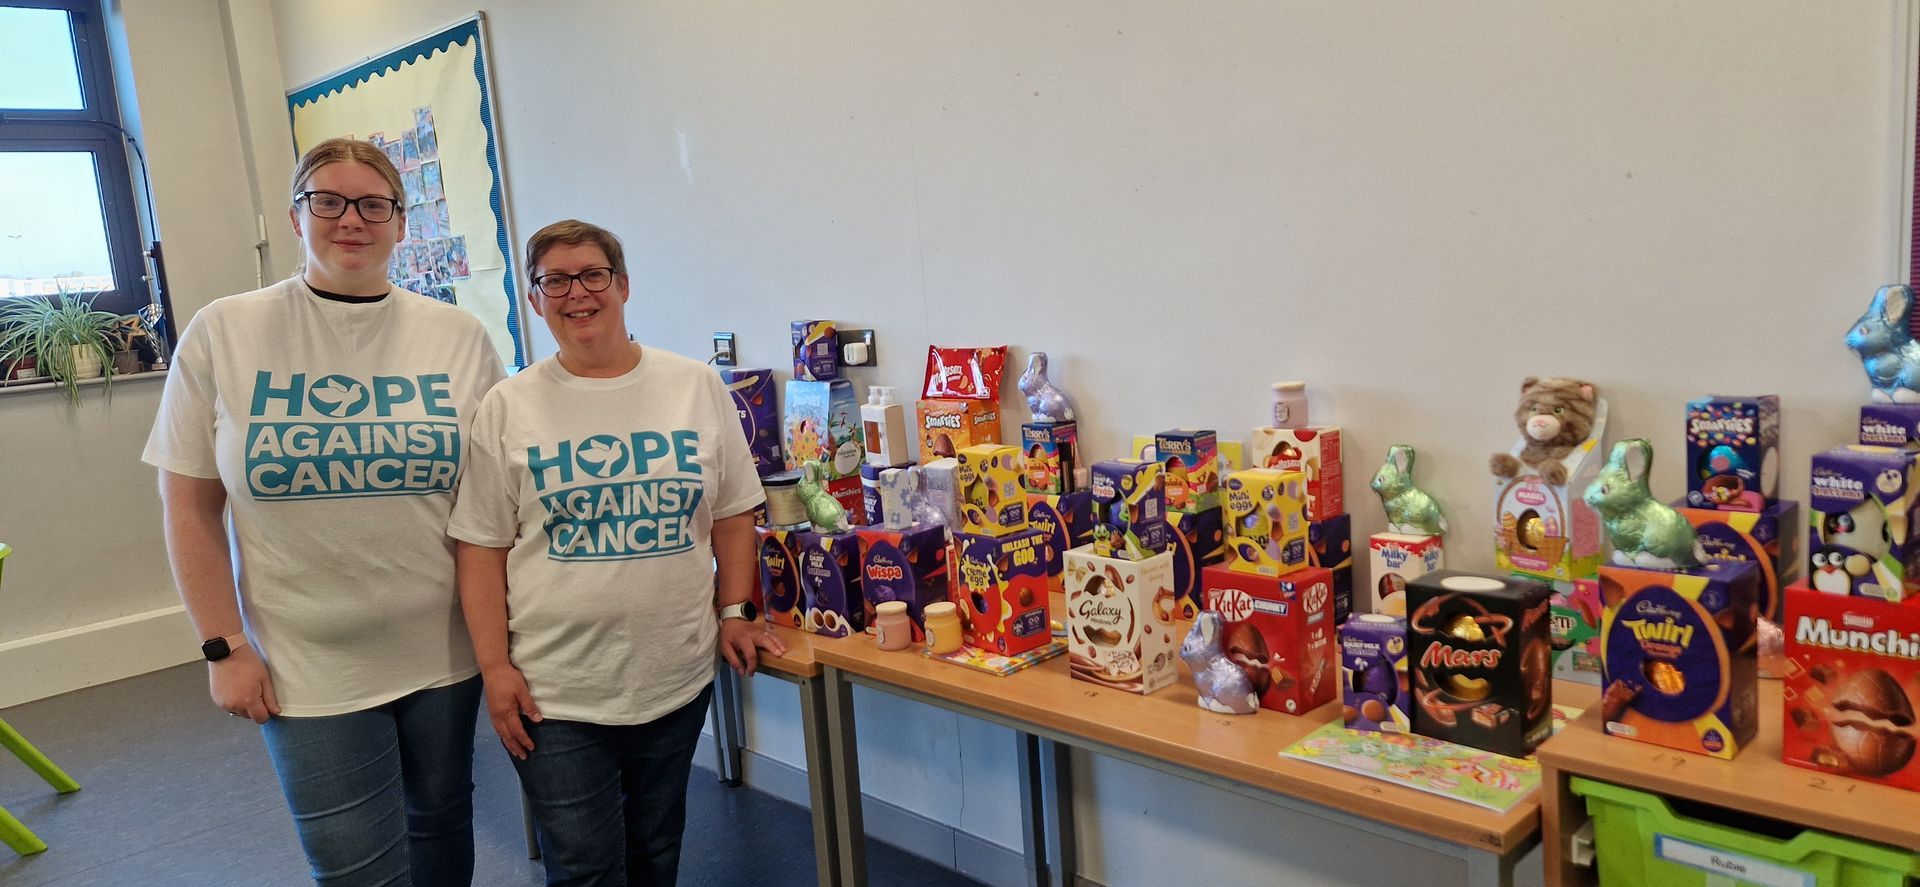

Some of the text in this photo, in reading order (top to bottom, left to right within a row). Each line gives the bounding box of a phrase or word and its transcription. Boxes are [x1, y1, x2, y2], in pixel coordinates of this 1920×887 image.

[250, 370, 457, 418] HOPE
[1862, 424, 1906, 434] white
[249, 424, 457, 459] AGAINST
[527, 430, 703, 490] HOPE
[959, 464, 973, 474] Mini
[250, 458, 456, 495] CANCER
[960, 473, 975, 483] eggs
[1813, 476, 1863, 490] white
[546, 481, 703, 525] AGAINST
[1229, 491, 1250, 501] Mini
[1230, 501, 1253, 511] eggs
[1031, 535, 1044, 546] THE
[1381, 548, 1408, 562] Milky
[1387, 558, 1401, 568] bar
[866, 564, 903, 580] Wispa
[969, 575, 985, 587] egg
[1079, 599, 1124, 622] Galaxy
[1622, 617, 1694, 646] Twirl
[1421, 641, 1502, 669] Mars
